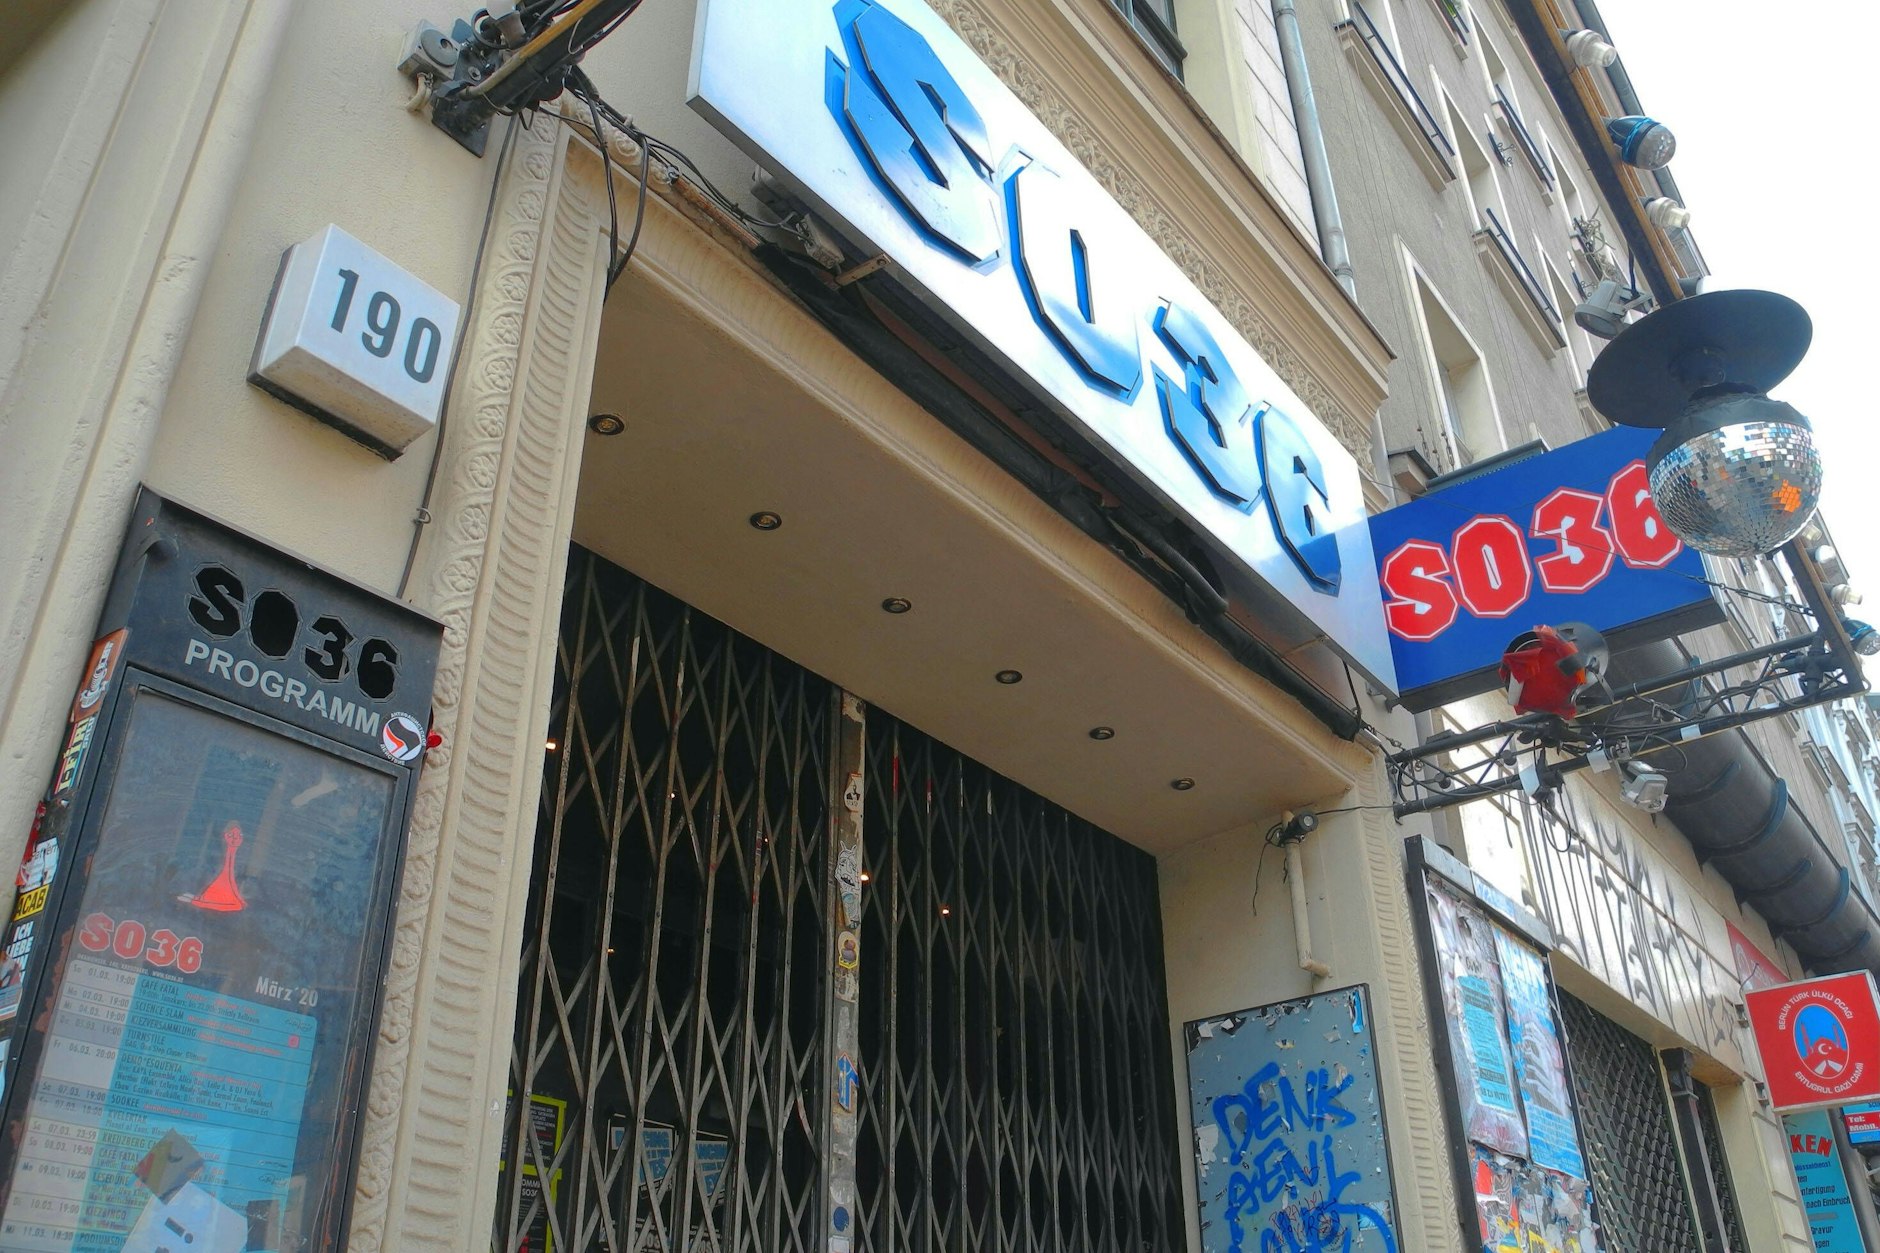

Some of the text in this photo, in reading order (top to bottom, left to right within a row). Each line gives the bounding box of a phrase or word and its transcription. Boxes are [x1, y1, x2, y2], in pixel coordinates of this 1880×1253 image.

[824, 0, 1341, 596] SO36
[331, 268, 442, 384] 190
[1381, 458, 1684, 643] SO36
[185, 561, 402, 704] SO36
[184, 637, 381, 738] PROGRAMM
[15, 890, 46, 917] ACAB
[14, 920, 35, 943] ICH
[78, 912, 204, 974] SO36
[114, 972, 136, 986] 19:00
[158, 982, 179, 996] FATAL
[108, 995, 130, 1008] 19:00
[133, 1000, 184, 1020] SCIENCE SLAM
[104, 1009, 126, 1022] 19:00
[129, 1014, 197, 1038] KIEZVERSAMMLUNG
[126, 1028, 166, 1046] TURNSTILE
[94, 1047, 117, 1061] 20:00
[84, 1088, 107, 1102] 19:00
[110, 1093, 140, 1108] SOOKEE
[1848, 1115, 1866, 1124] Tel:
[46, 1122, 72, 1136] 07.03.
[101, 1131, 146, 1149] KREUZBERG
[1790, 1133, 1833, 1158] KEN
[1806, 1199, 1822, 1209] nach
